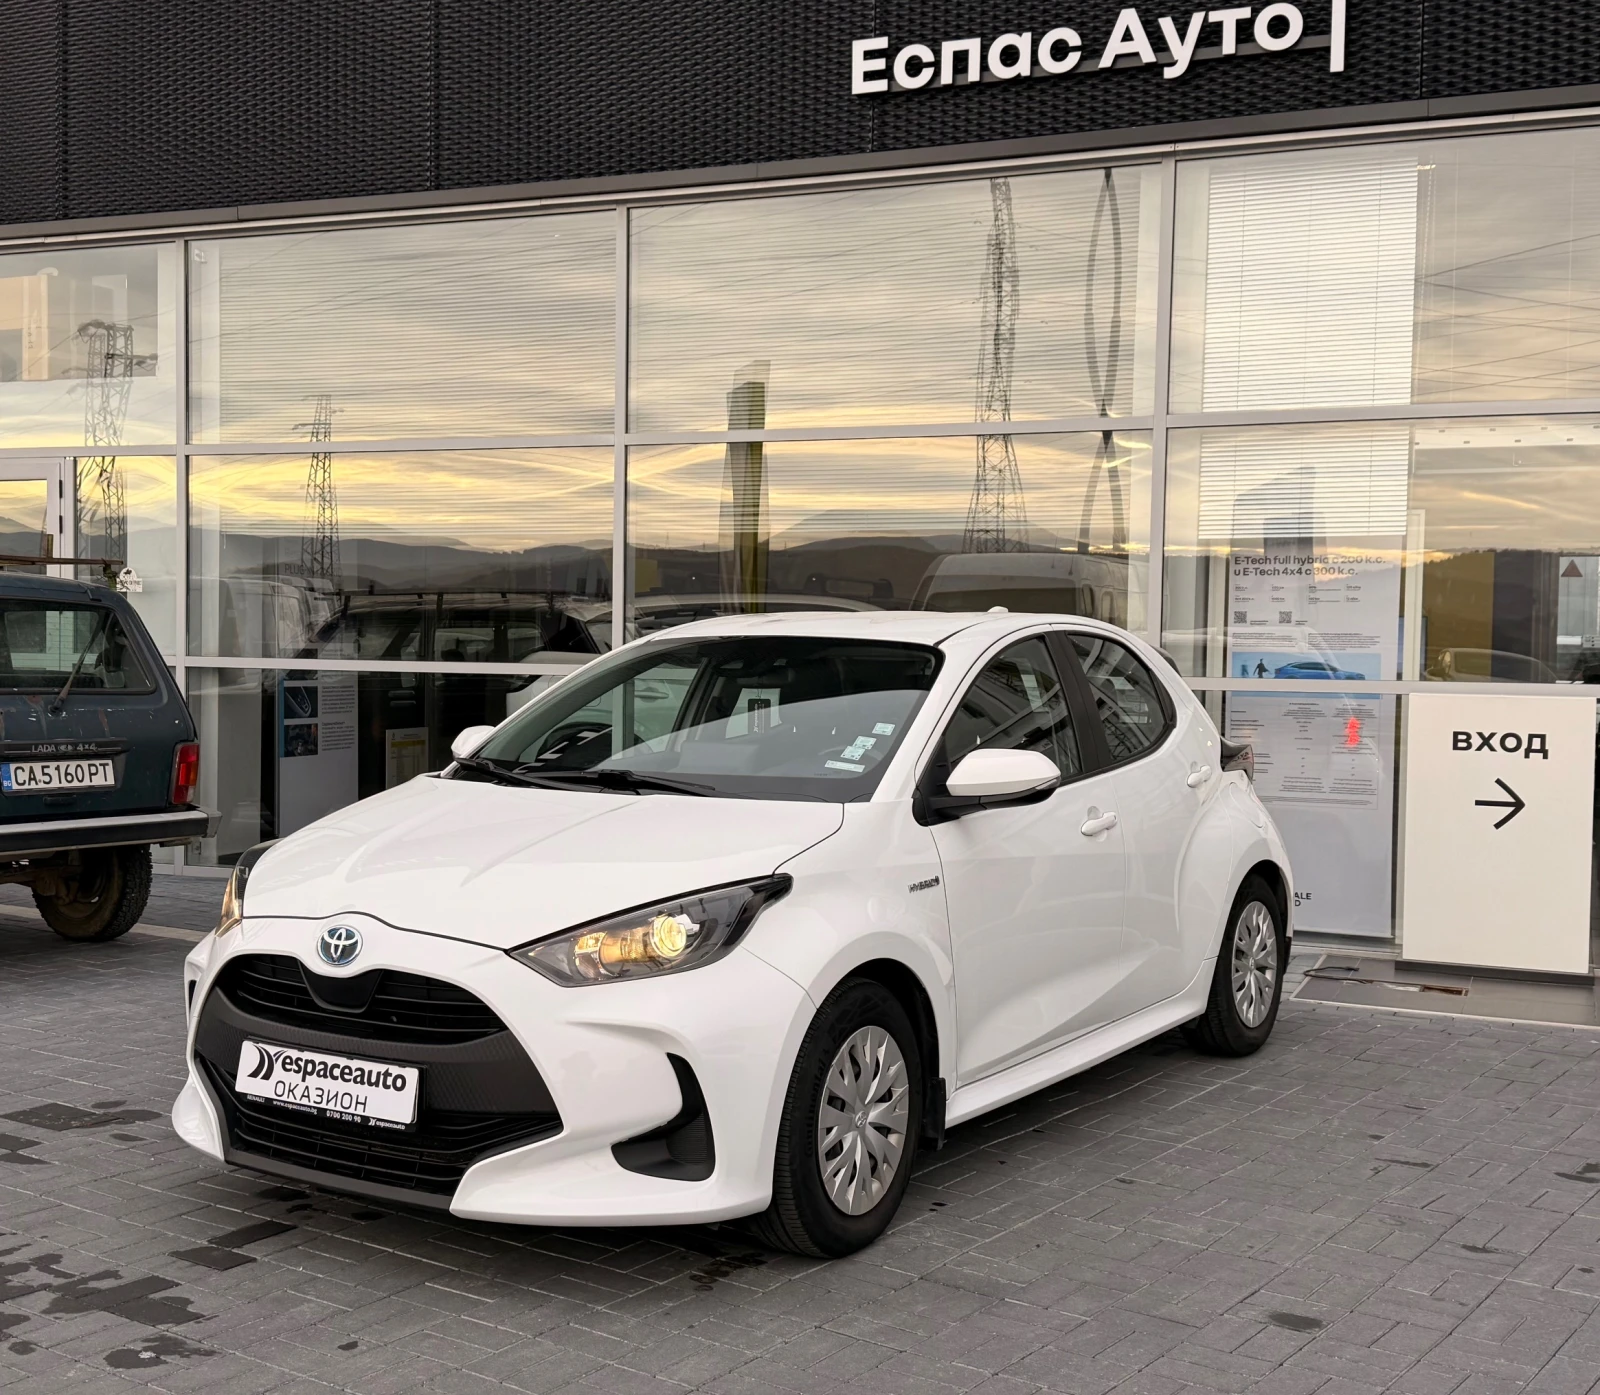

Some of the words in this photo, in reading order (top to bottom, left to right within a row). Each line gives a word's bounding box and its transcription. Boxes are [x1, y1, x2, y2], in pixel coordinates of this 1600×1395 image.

[851, 27, 1083, 95] Еспас
[1098, 2, 1304, 80] Ауто
[1234, 555, 1272, 565] E-Tech
[1273, 555, 1291, 565] full
[1243, 567, 1280, 576] E-Tech
[1282, 567, 1304, 576] 4x4
[1313, 566, 1336, 576] 300
[32, 744, 56, 753] LADA
[281, 1054, 407, 1091] espaceauto
[274, 1080, 368, 1113] ОКАЗИОН
